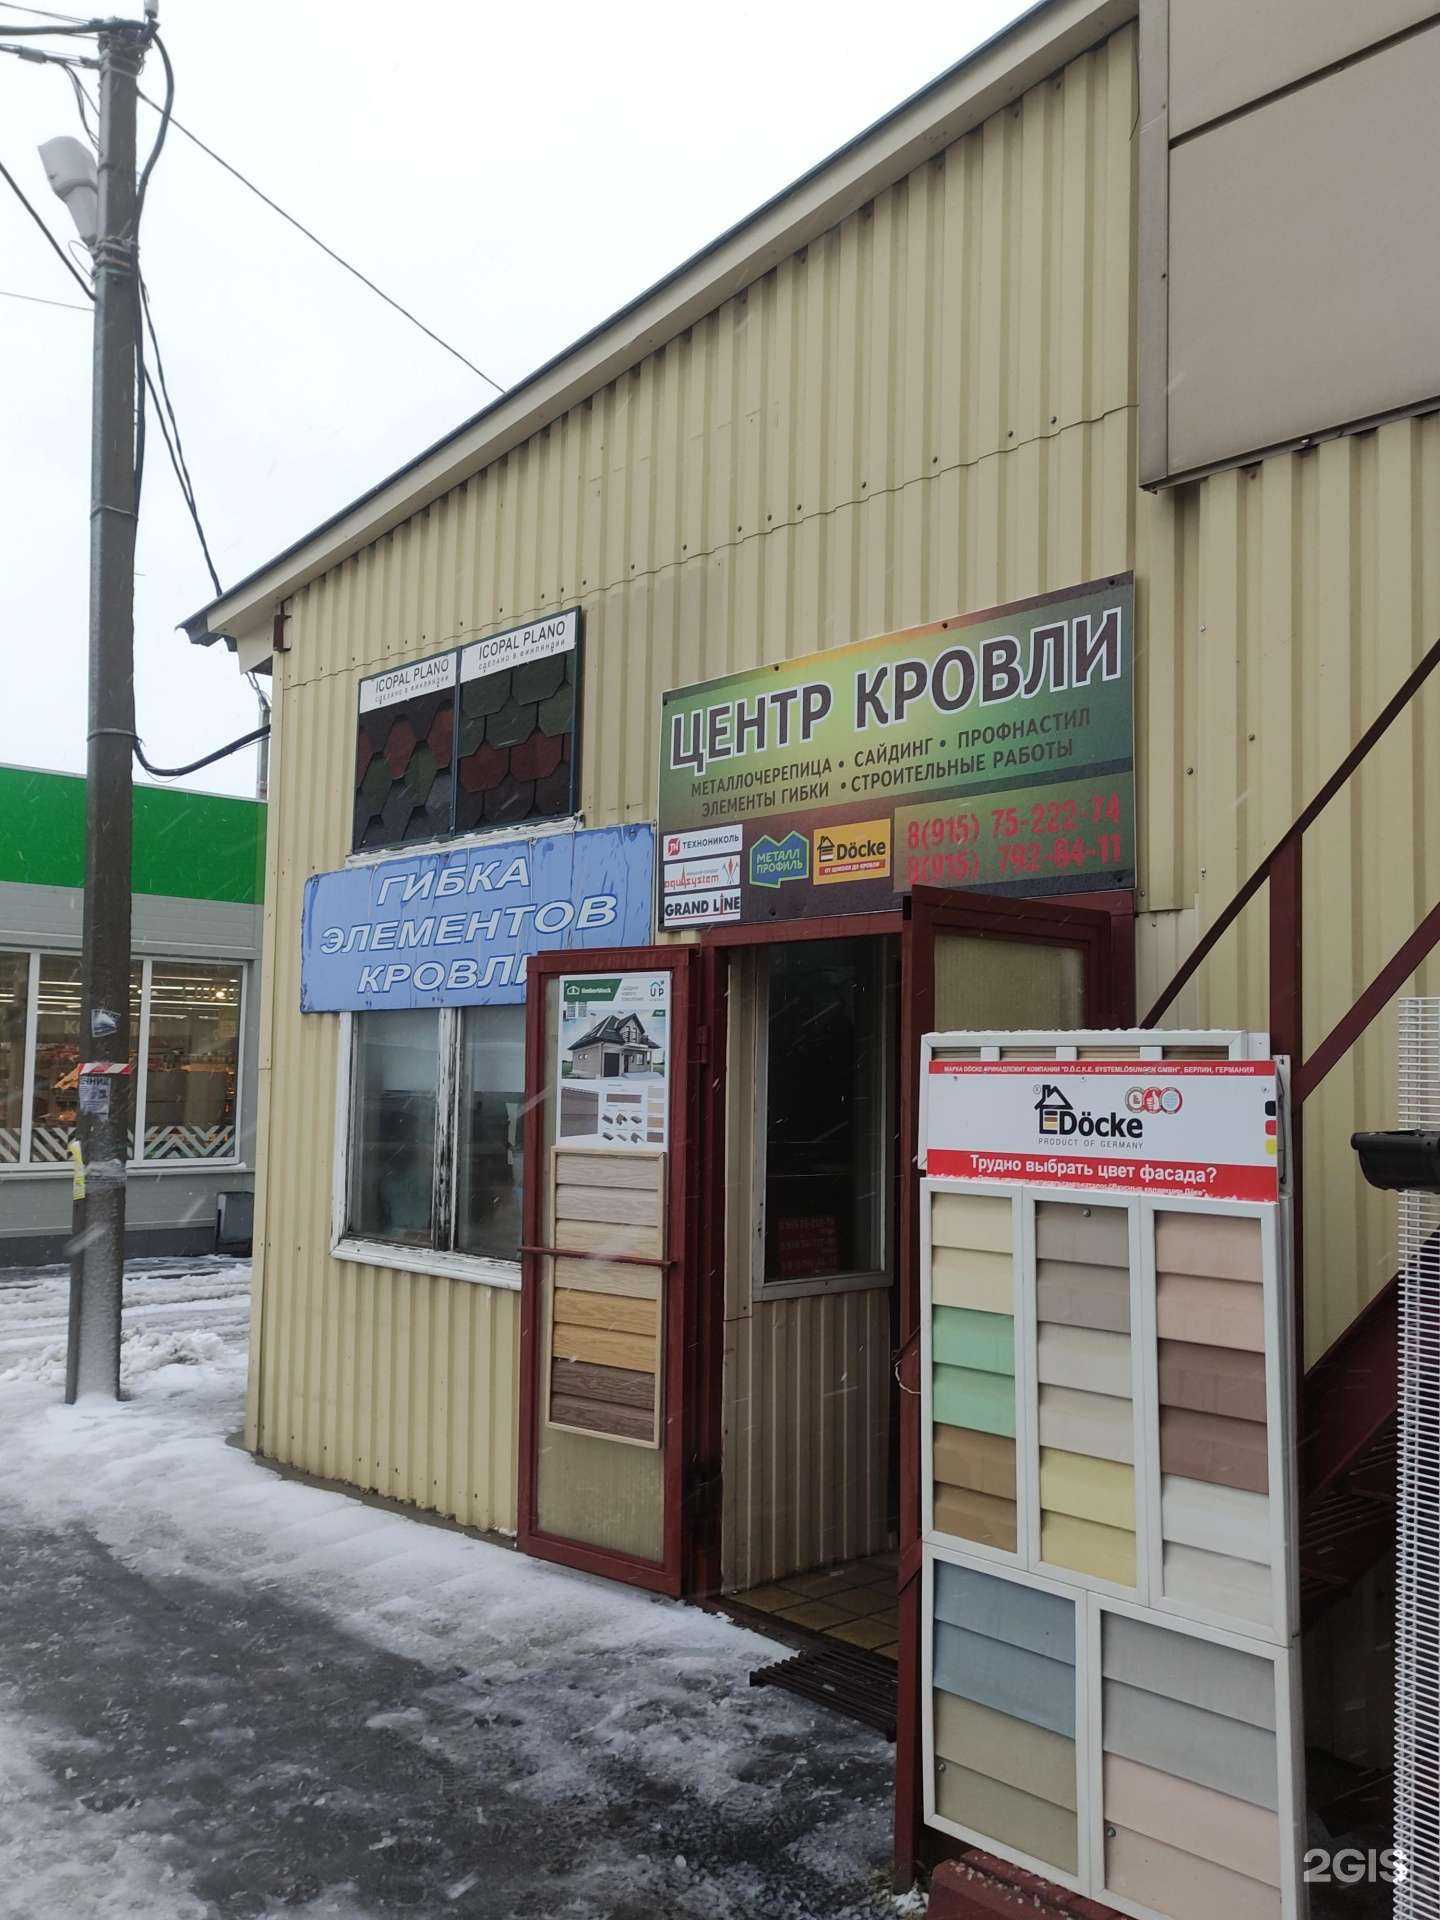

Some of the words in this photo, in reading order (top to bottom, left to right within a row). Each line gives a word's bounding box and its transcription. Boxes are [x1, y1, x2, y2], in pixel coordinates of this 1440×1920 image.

[478, 635, 520, 660] ICOPAL
[523, 620, 565, 646] PLANO
[375, 670, 410, 694] ICOPAL
[413, 658, 449, 681] PLANO
[670, 680, 833, 775] ЦЕНТР
[854, 606, 1123, 731] КРОВЛИ
[691, 758, 833, 798] МЕТАЛЛОЧЕРЕПИЦА
[854, 737, 934, 768] САЙДИНГ
[957, 707, 1091, 749] ПРОФНАСТИЛ
[702, 790, 777, 818] ЭЛЕМЕНТЫ
[781, 782, 829, 805] ГИБКИ
[851, 753, 986, 793] СТРОИТЕЛЬНЫЕ
[993, 738, 1073, 769] РАБОТЫ
[907, 814, 980, 851] 8(915)
[991, 792, 1120, 838] 75-222-74
[682, 834, 740, 850] ТЕХНОНИКОЛЬ
[756, 848, 800, 864] МЕТАЛЛ
[837, 840, 886, 861] Döcke
[377, 856, 530, 907] ГИБКА
[756, 860, 803, 875] ПРОФИЛЬ
[665, 900, 709, 918] GRAND
[319, 893, 618, 956] ЭЛЕМЕНТОВ
[1215, 1066, 1255, 1074] ГЕРМАНИЯ
[1059, 1111, 1143, 1138] Döcke
[1038, 1137, 1078, 1147] PRODUCT
[1083, 1139, 1096, 1147] OF
[1100, 1140, 1144, 1150] GERMANY
[970, 1154, 1022, 1173] Трудно
[1025, 1158, 1093, 1177] выбрать
[1097, 1163, 1135, 1180] цвет
[1139, 1163, 1217, 1184] фасада?
